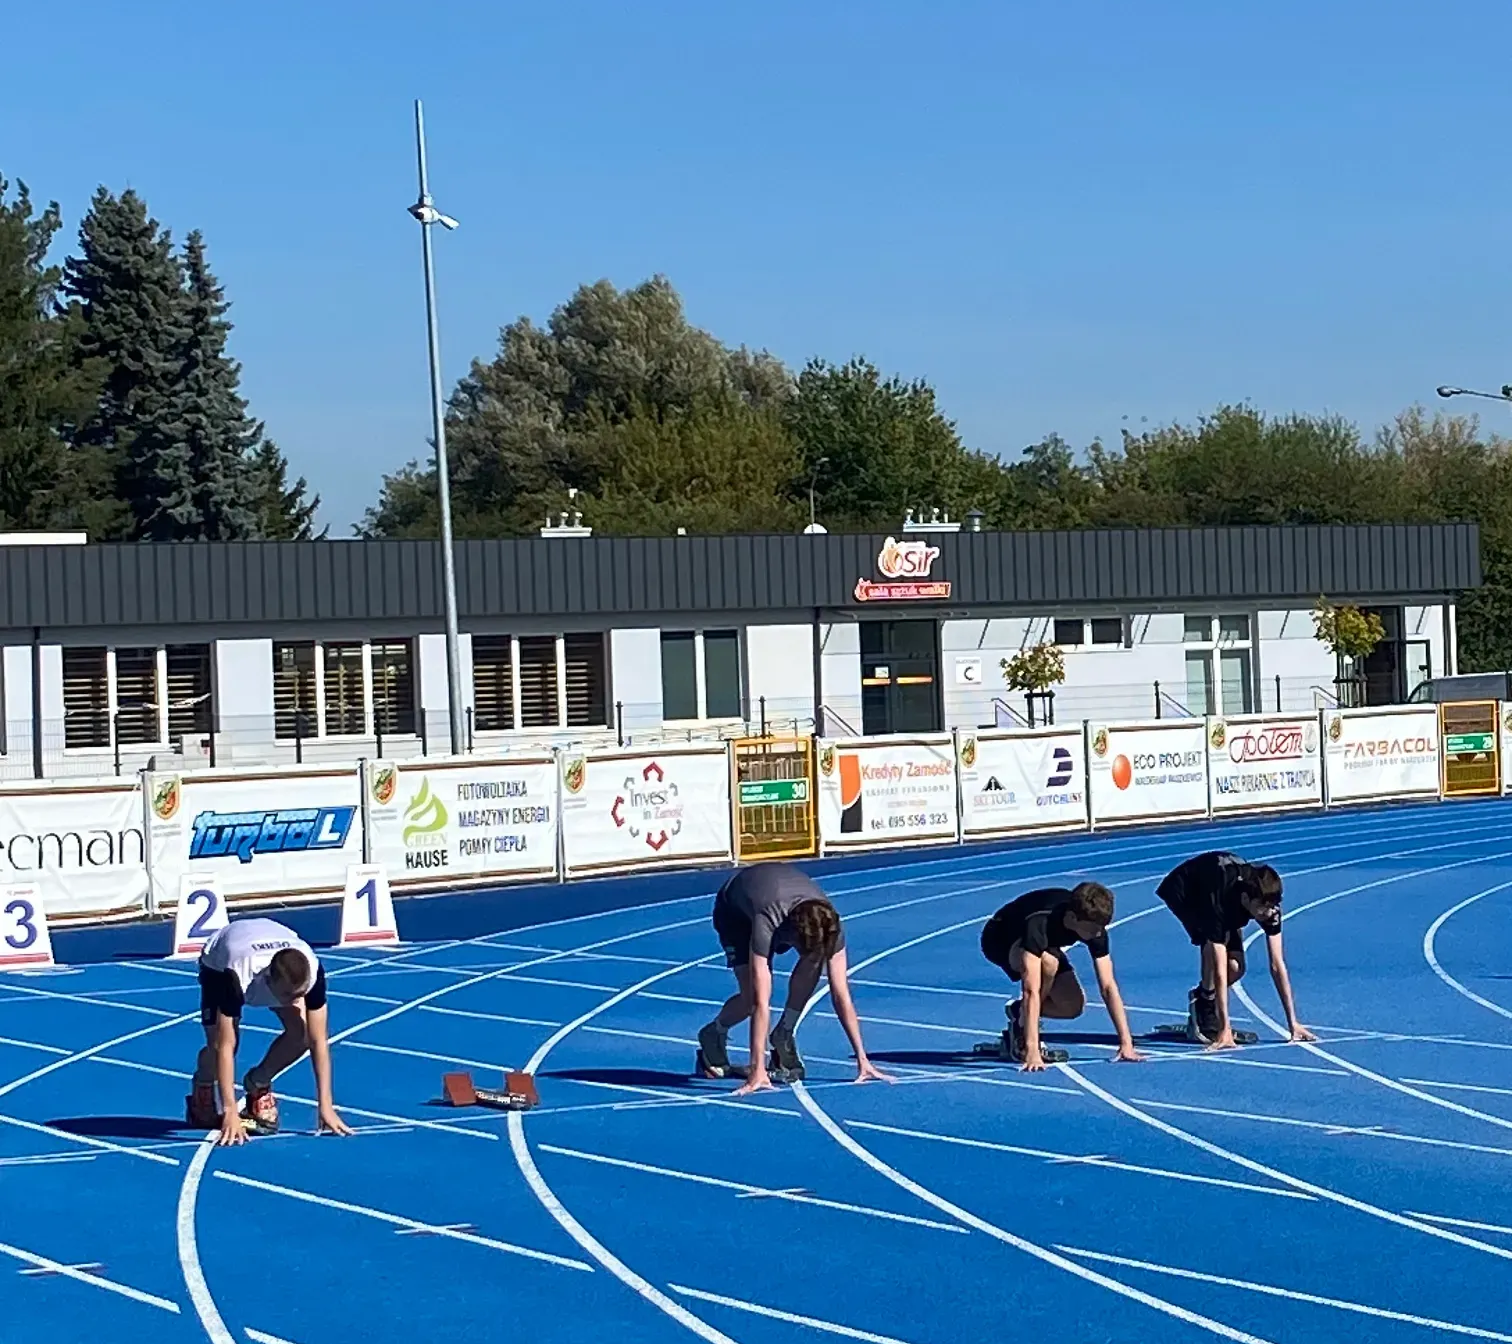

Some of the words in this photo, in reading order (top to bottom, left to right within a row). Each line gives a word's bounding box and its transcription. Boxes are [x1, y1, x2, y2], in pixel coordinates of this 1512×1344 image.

[1344, 738, 1437, 759] FARBACOL
[861, 763, 904, 783] Kredyty
[905, 759, 953, 777] Zamość
[1133, 753, 1156, 770] ECO
[1158, 751, 1202, 769] PROJEKT
[456, 780, 528, 801] FOTOWOLTAIKA
[629, 788, 669, 808] Invest
[791, 782, 806, 799] 30
[458, 807, 511, 828] MAGAZYNY
[929, 812, 949, 825] 323
[0, 828, 144, 871] cman
[405, 849, 449, 869] HAUSE
[355, 878, 379, 927] 1
[3, 899, 38, 949] 3
[187, 889, 219, 939] 2
